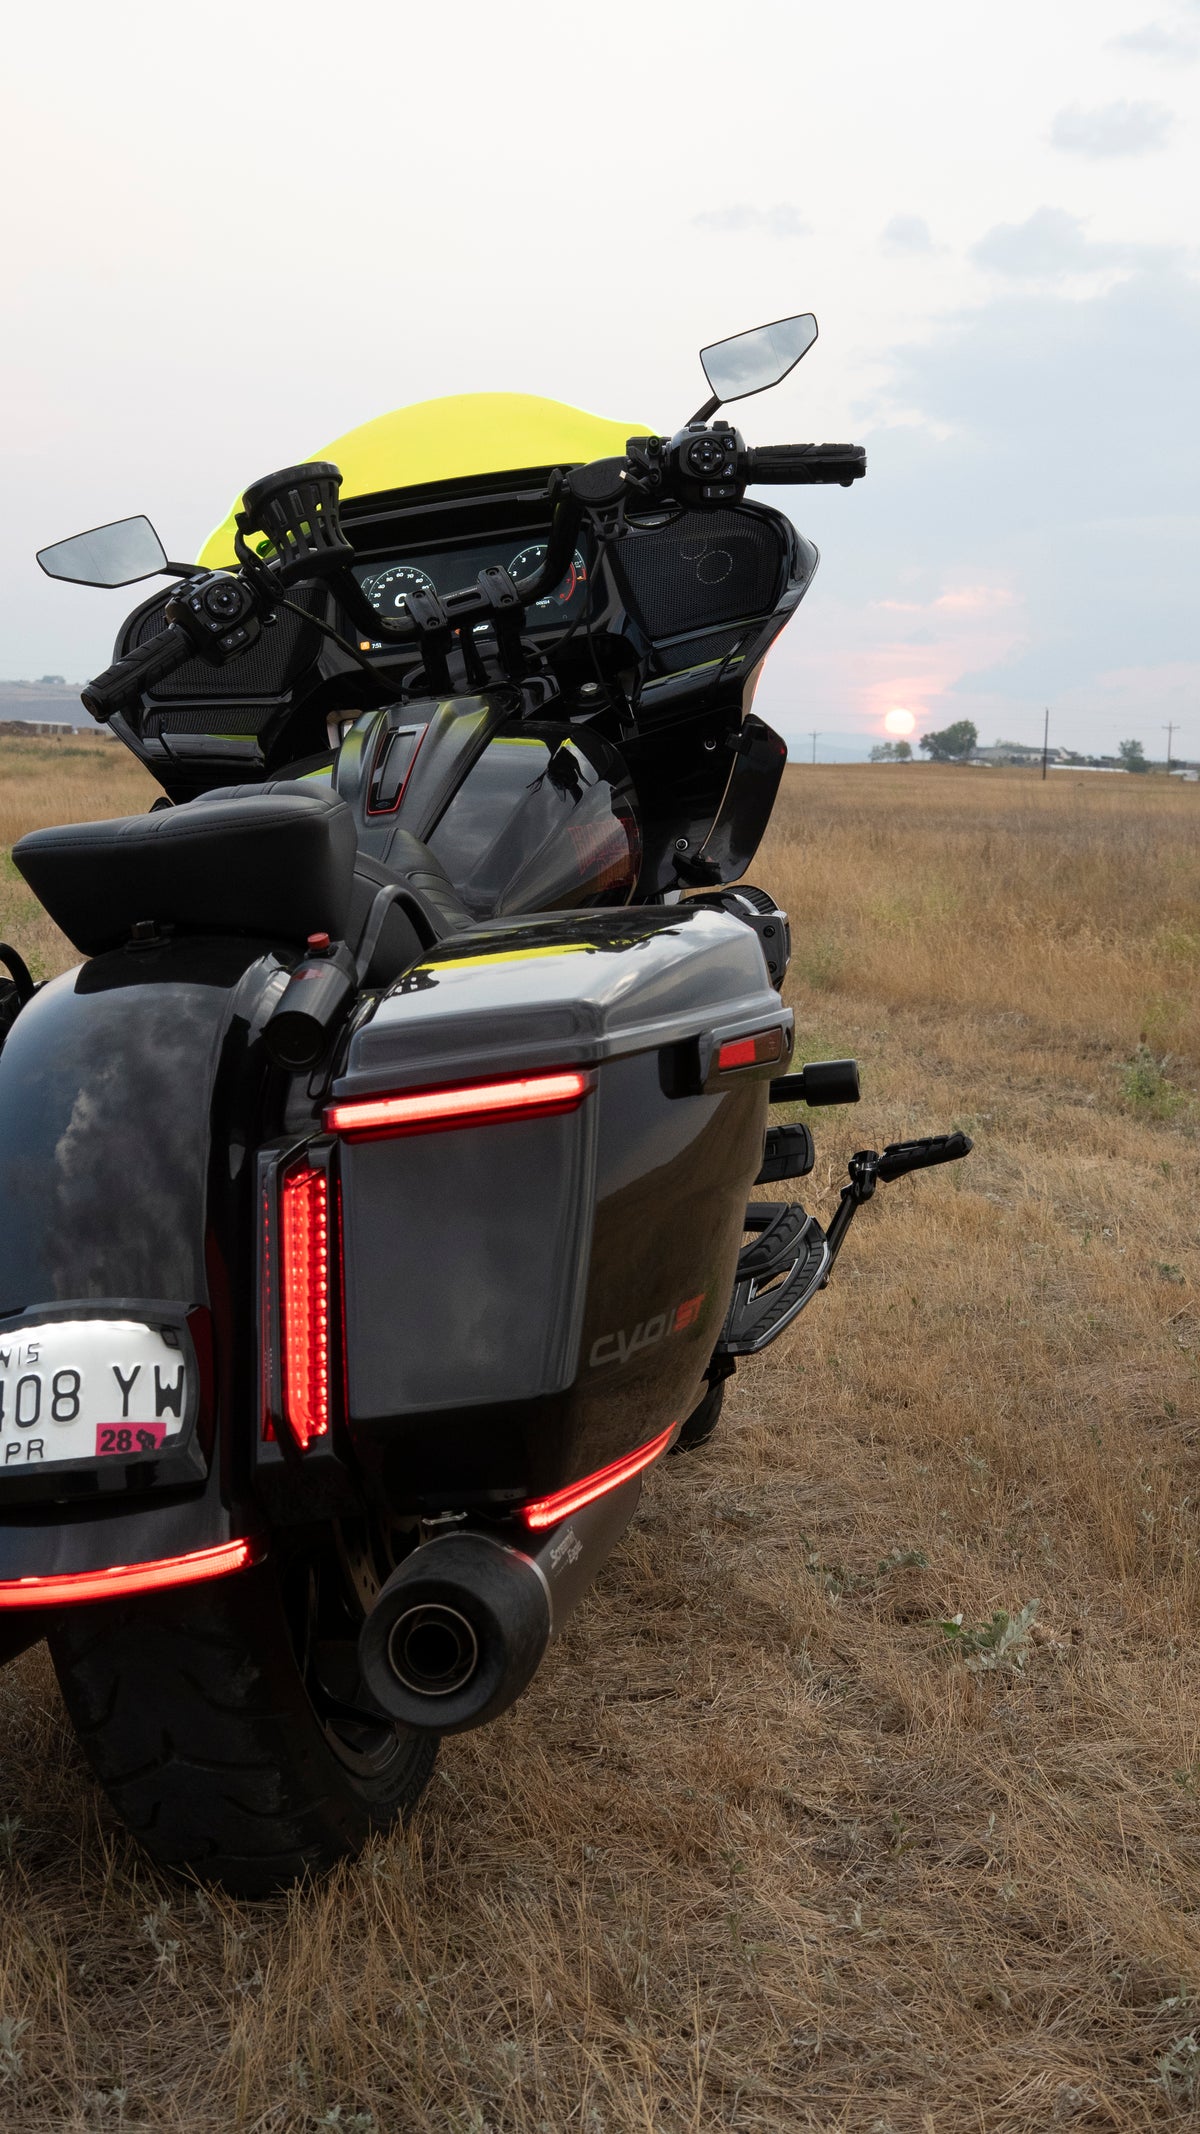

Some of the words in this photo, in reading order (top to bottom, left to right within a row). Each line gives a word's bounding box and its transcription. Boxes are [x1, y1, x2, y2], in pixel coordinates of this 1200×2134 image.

[0, 1369, 81, 1434] 08
[112, 1365, 185, 1418] YW
[100, 1429, 132, 1453] 28
